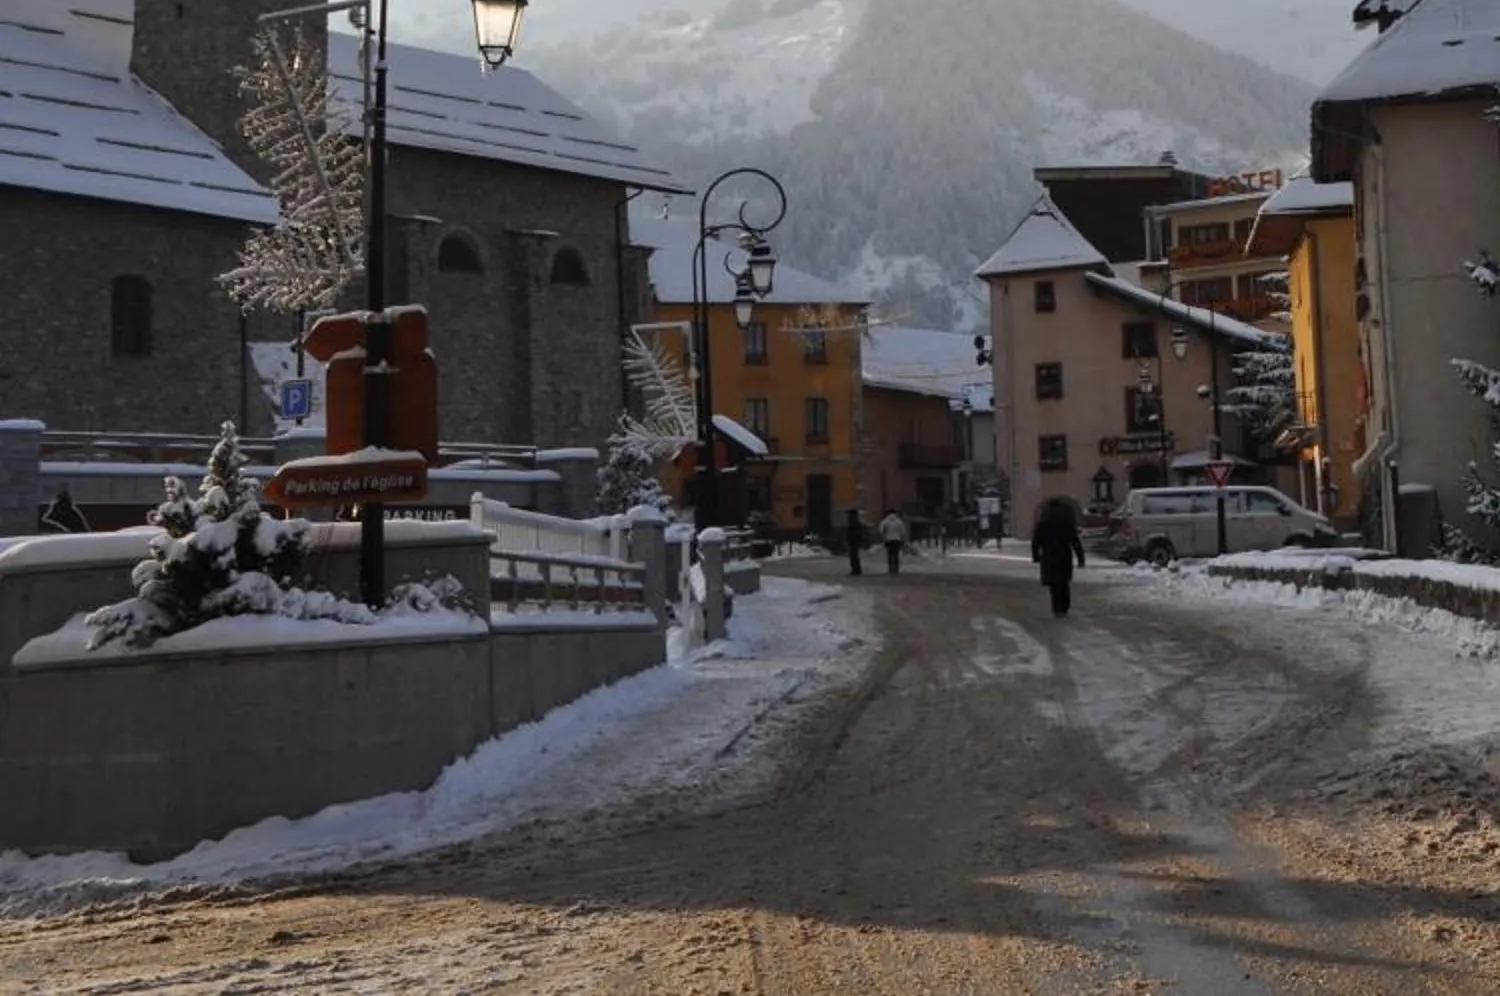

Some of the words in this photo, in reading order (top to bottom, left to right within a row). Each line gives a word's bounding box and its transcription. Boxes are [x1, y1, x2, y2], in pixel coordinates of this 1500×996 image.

[289, 388, 303, 412] P
[285, 479, 340, 495] Parking
[343, 477, 360, 492] de
[383, 508, 456, 522] PARKING
